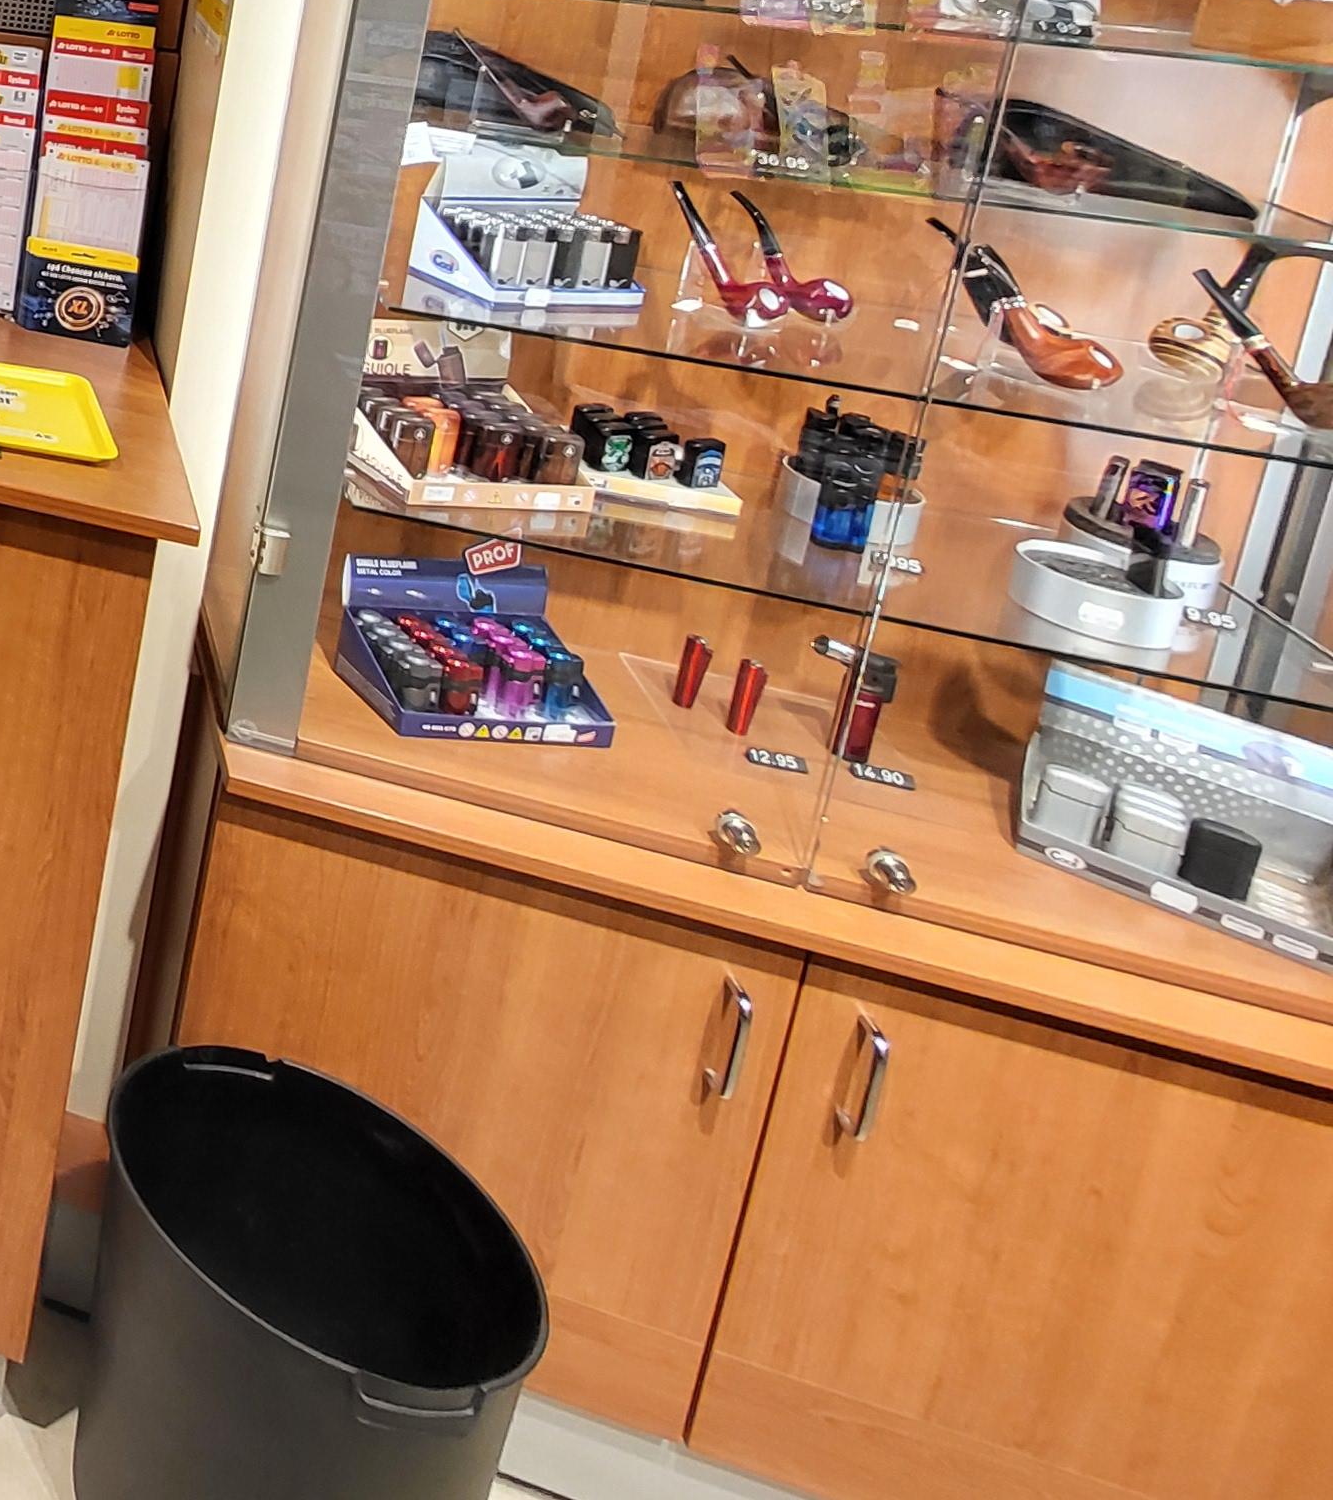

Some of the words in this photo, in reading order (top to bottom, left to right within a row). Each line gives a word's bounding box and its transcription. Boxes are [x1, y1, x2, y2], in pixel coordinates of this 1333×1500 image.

[66, 123, 94, 135] LOTTO
[66, 153, 93, 165] LOTTO
[68, 300, 88, 315] XL
[472, 544, 514, 569] PROF
[1185, 607, 1238, 630] 9.95
[749, 748, 798, 769] 12.95
[853, 762, 905, 786] 14.90
